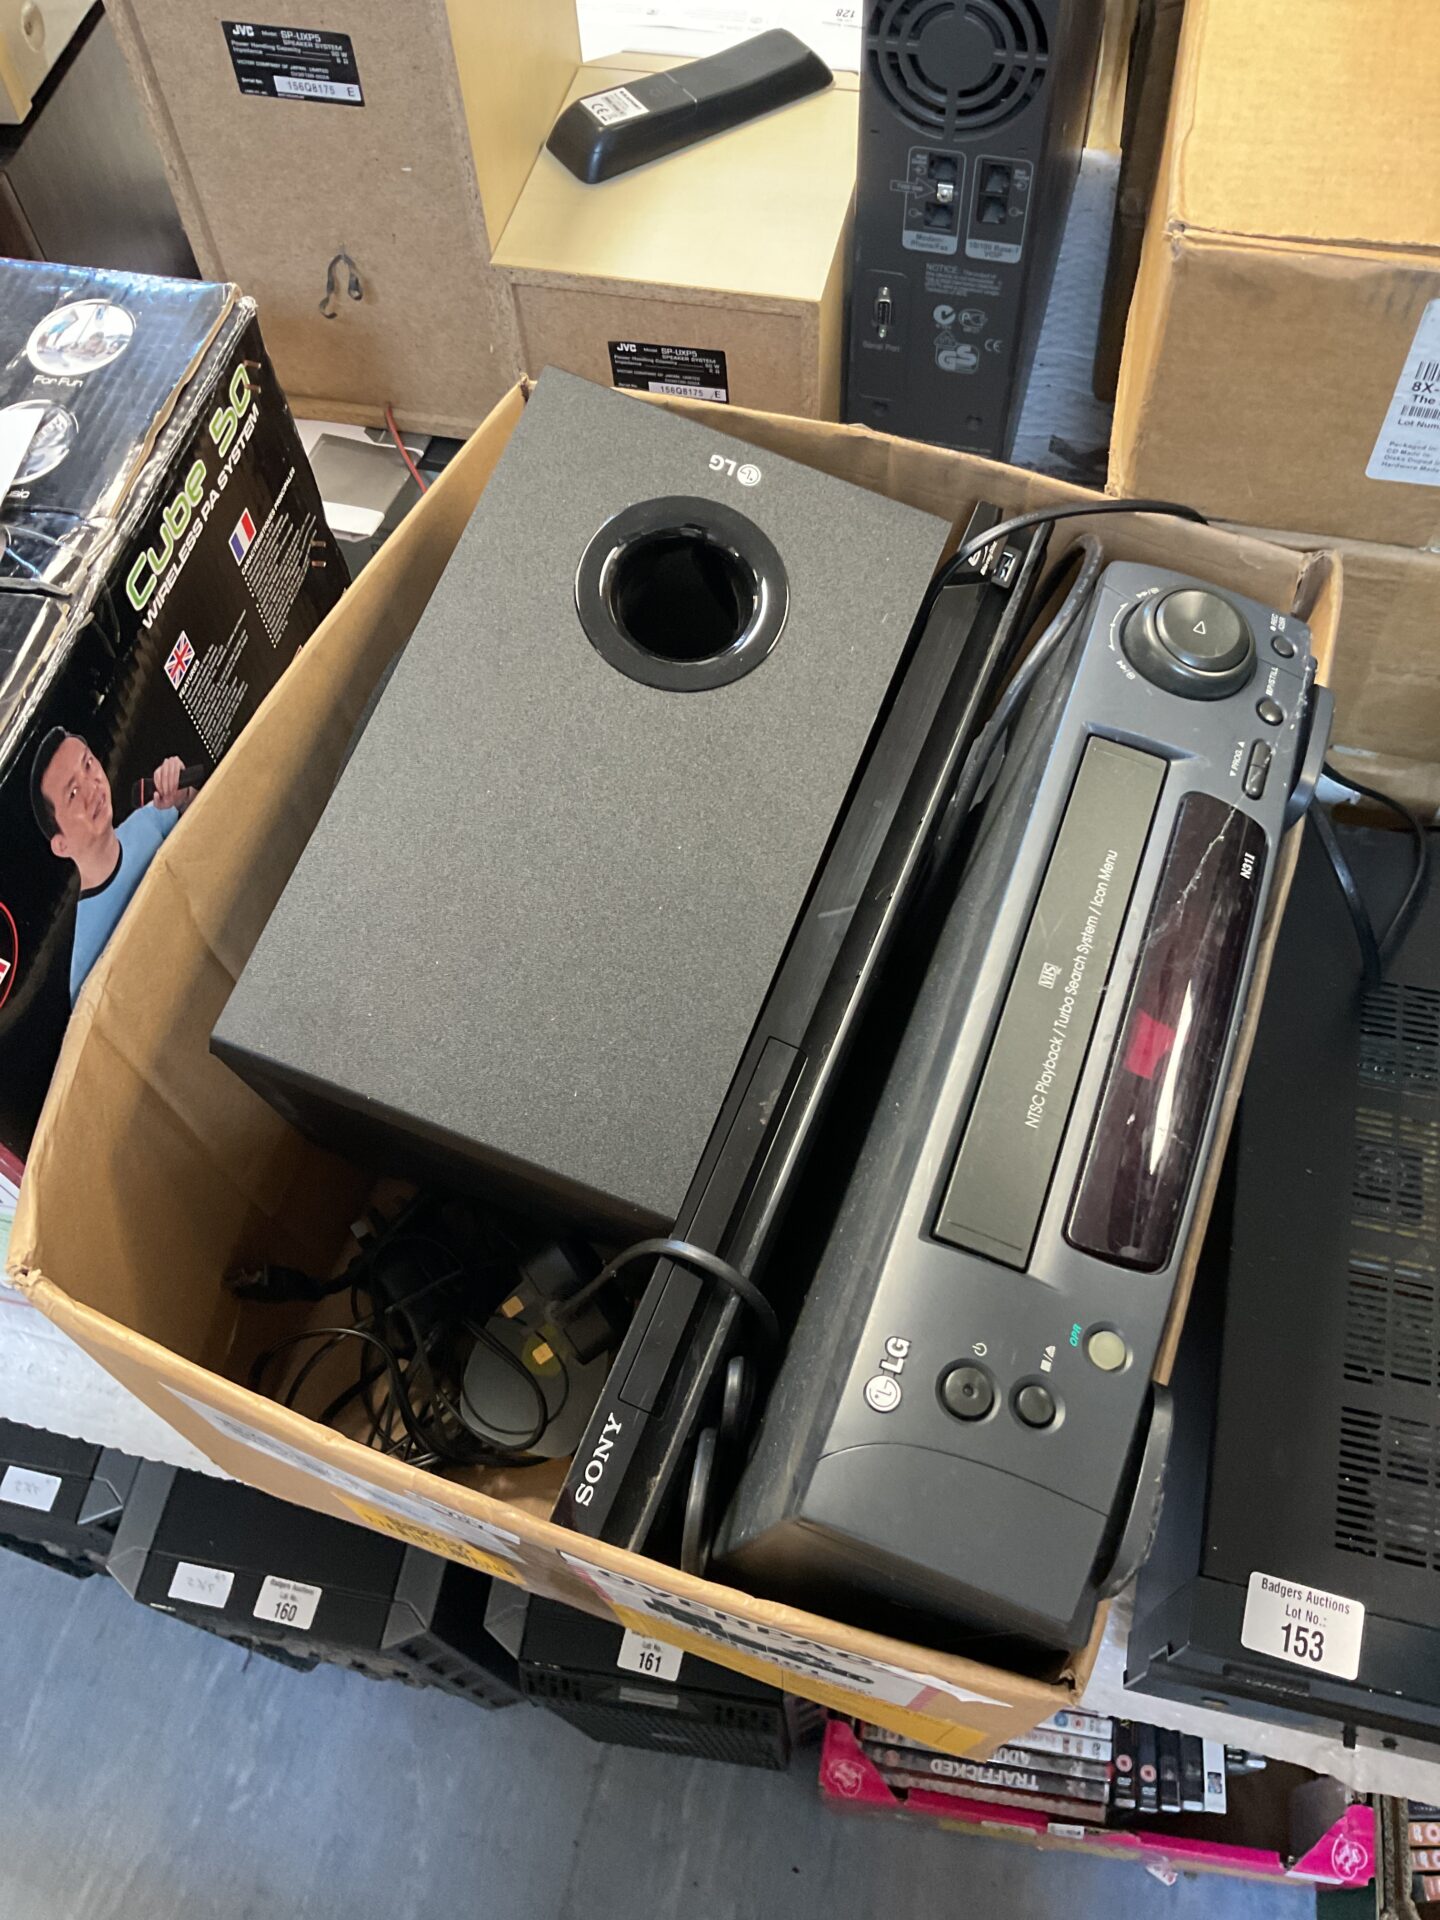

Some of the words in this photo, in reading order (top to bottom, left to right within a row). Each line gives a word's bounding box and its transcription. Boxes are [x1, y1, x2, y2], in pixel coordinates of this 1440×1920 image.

[835, 8, 856, 19] 128
[232, 24, 254, 37] JVC
[280, 30, 321, 42] SP-UXP5
[283, 40, 313, 48] SPEAKER
[315, 43, 342, 51] SYSTEM
[347, 86, 355, 97] E
[616, 343, 637, 352] JVC
[661, 348, 697, 358] SP-UXP5
[33, 375, 57, 385] For
[58, 377, 83, 387] Fun
[208, 363, 251, 458] 50
[1413, 394, 1435, 405] The
[1398, 418, 1414, 426] Lot
[1417, 421, 1440, 430] Num
[709, 454, 737, 476] LG
[142, 517, 204, 629] WIRELESS
[201, 489, 220, 519] PA
[217, 402, 260, 494] SYSTEM
[178, 659, 200, 699] FEATURES
[1100, 850, 1118, 883] Menu
[1092, 881, 1109, 907] Icon
[1077, 918, 1098, 956] System
[1064, 955, 1087, 996] Search
[1054, 996, 1075, 1030] Turbo
[1035, 1036, 1063, 1096] Playback
[1024, 1095, 1045, 1129] NTSC
[1069, 1323, 1082, 1347] OPR
[881, 1336, 911, 1374] LG
[575, 1412, 622, 1507] SONY
[275, 1601, 298, 1621] 160
[1261, 1577, 1302, 1600] Badgers
[1306, 1591, 1350, 1615] Auctions
[1285, 1604, 1302, 1620] Lot
[596, 1568, 886, 1668] OVERPAC
[1281, 1622, 1325, 1662] 153
[639, 1651, 662, 1673] 161
[930, 1758, 1040, 1792] TRAFFICKED
